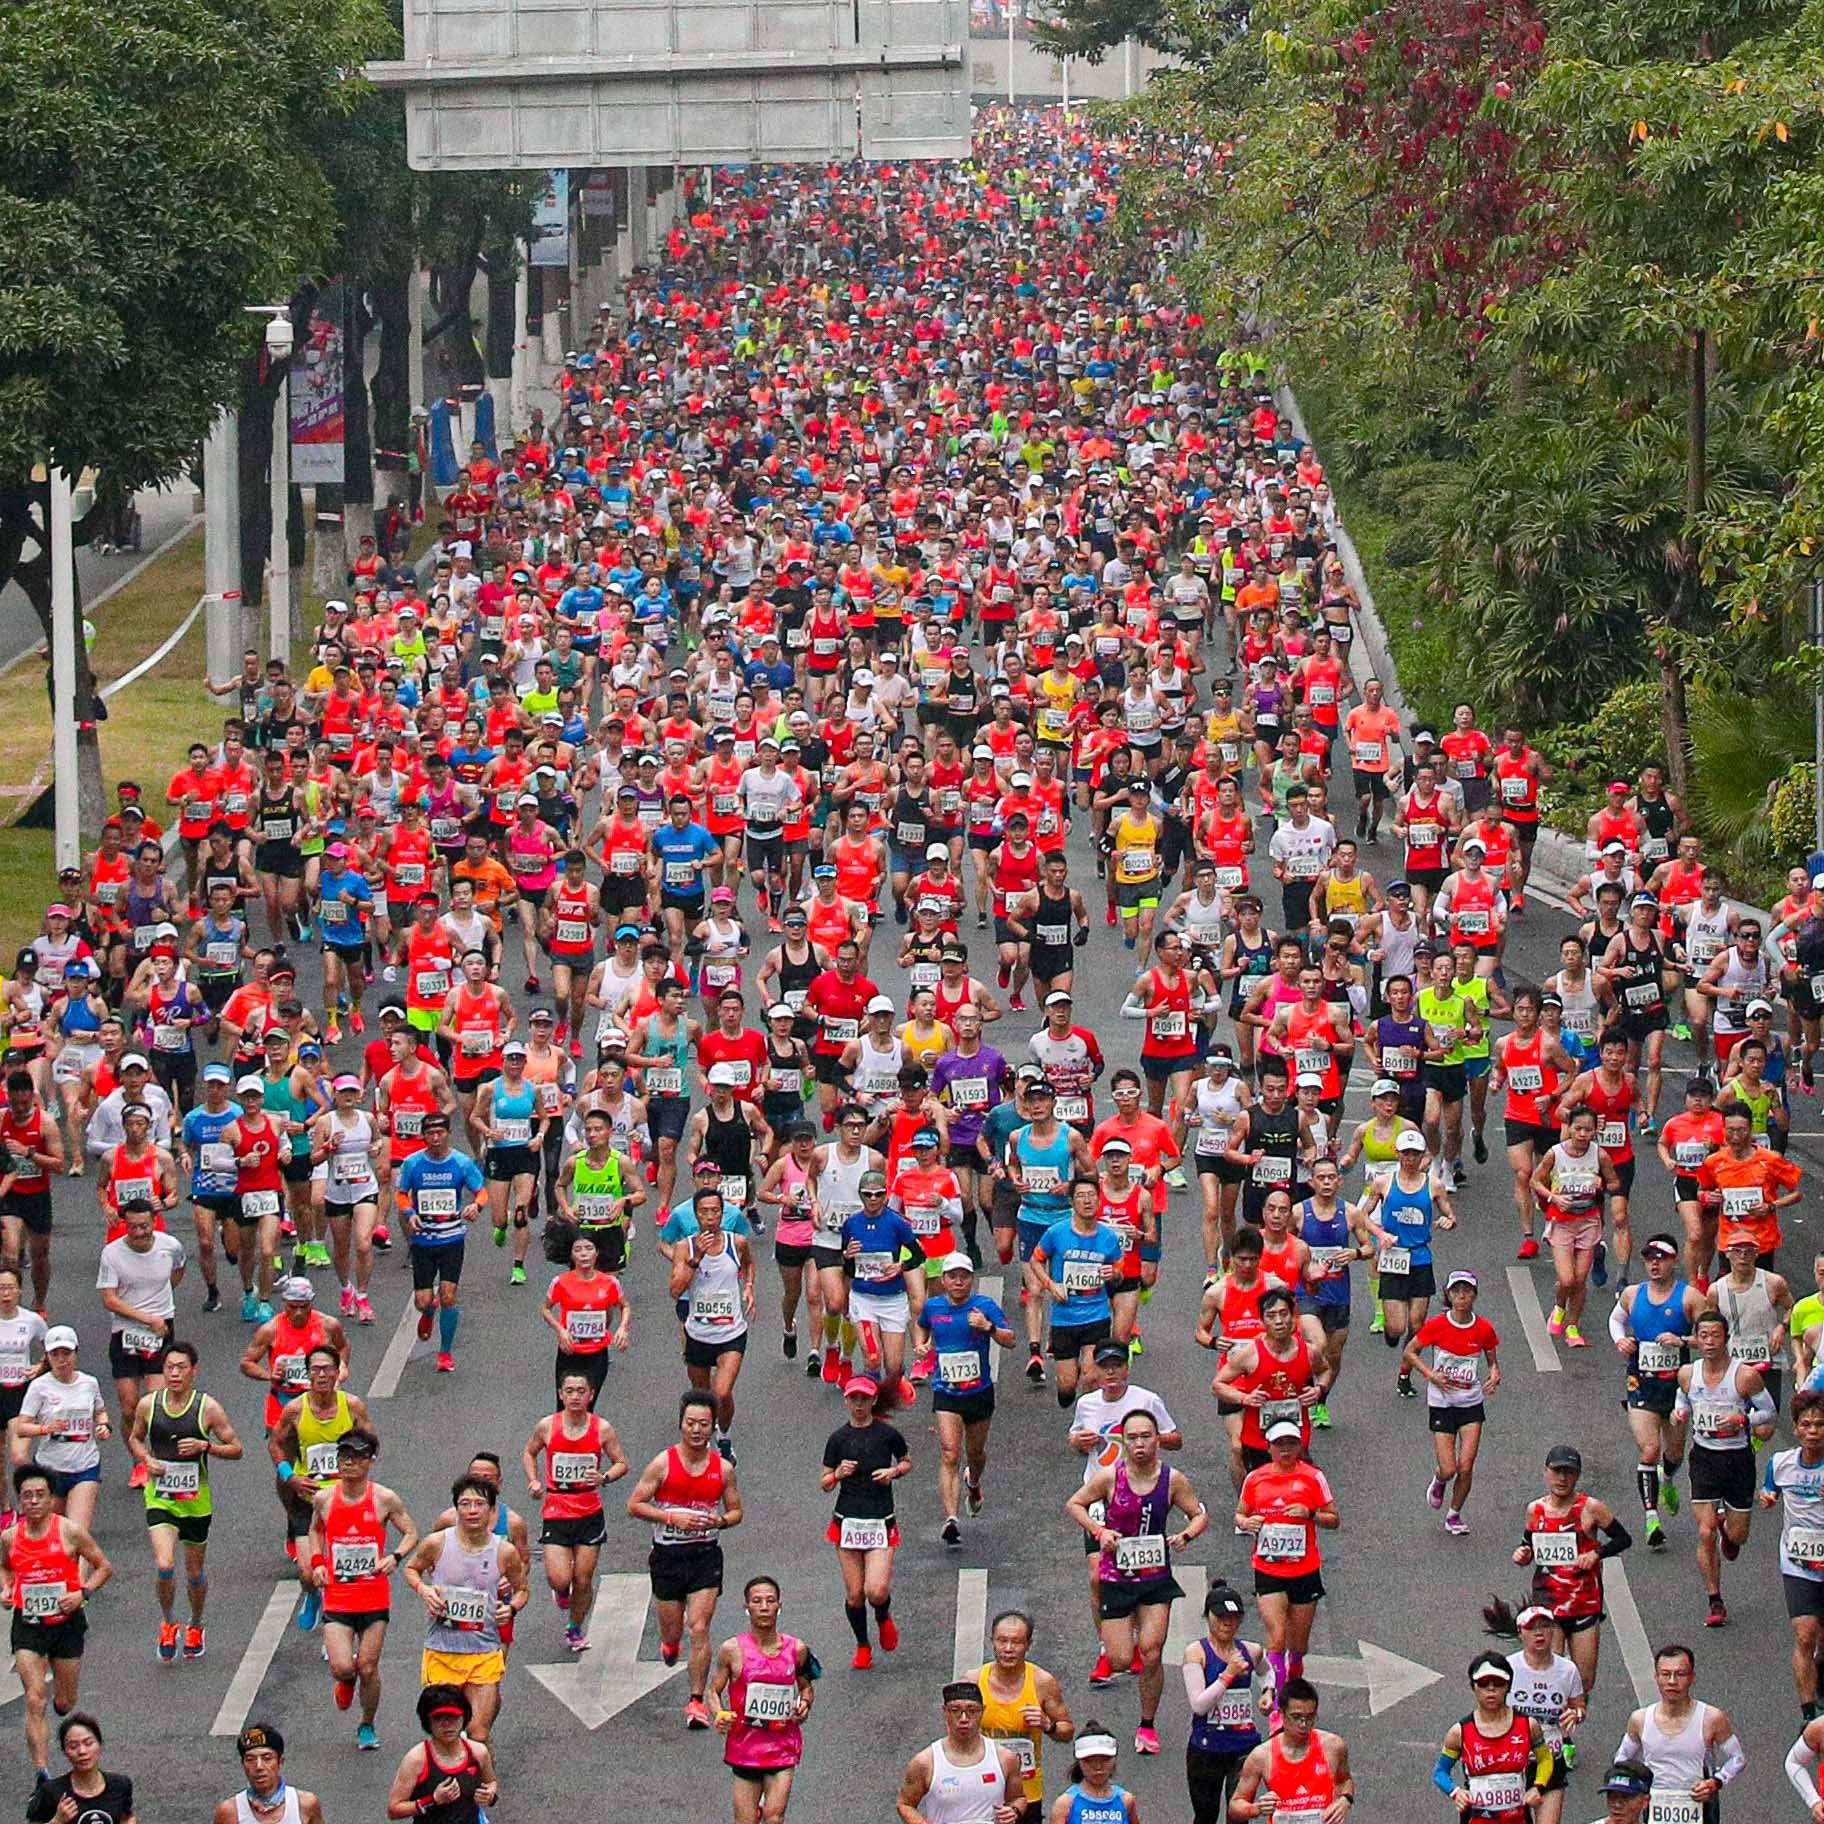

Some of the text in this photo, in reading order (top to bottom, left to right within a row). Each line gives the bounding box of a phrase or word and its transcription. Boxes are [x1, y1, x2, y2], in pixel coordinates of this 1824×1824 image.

[913, 1219, 937, 1230] 9219
[1641, 1355, 1678, 1367] A1262
[941, 1364, 976, 1379] A1733
[158, 1474, 195, 1488] A2045
[1261, 1537, 1303, 1552] A9737
[1120, 1549, 1162, 1565] A1833
[1537, 1547, 1574, 1561] A2428
[336, 1557, 376, 1572] A2424
[444, 1600, 482, 1616] A0816
[1211, 1703, 1251, 1719] A9856
[1475, 1789, 1520, 1806] A9888
[1652, 1805, 1699, 1823] B0304
